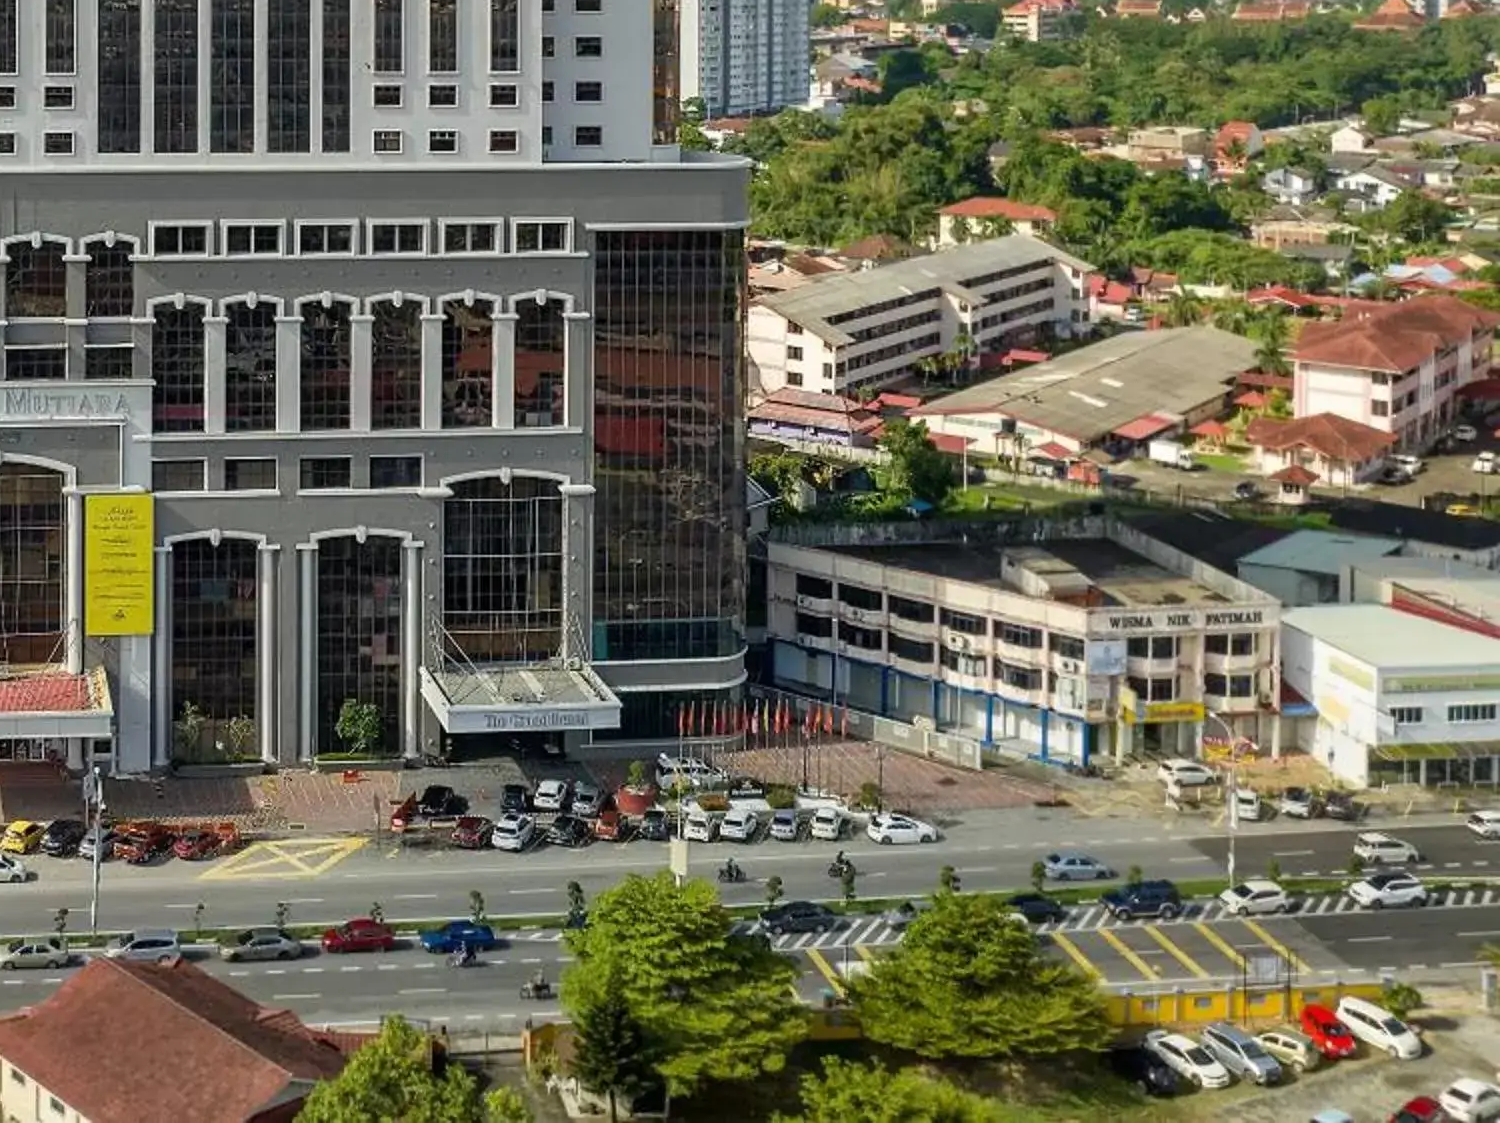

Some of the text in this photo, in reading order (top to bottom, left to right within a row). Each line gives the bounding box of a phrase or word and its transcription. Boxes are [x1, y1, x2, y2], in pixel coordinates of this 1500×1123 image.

[4, 387, 132, 415] MUTIARA
[1109, 615, 1153, 629] WISMA
[1166, 613, 1192, 627] NIK
